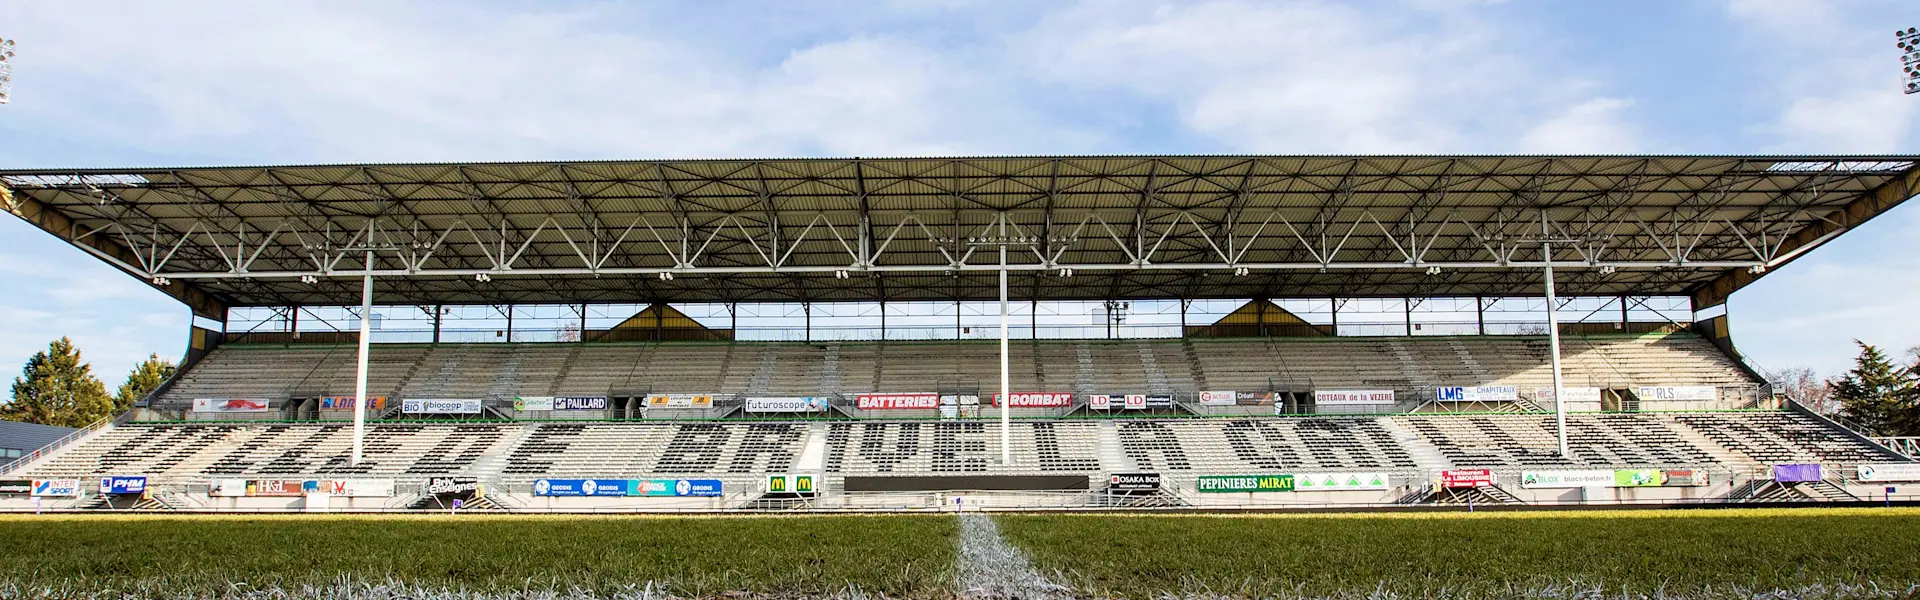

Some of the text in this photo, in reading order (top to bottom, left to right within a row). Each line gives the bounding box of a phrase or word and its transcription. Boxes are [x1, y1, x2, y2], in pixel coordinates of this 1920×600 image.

[1349, 393, 1358, 401] de
[1370, 393, 1393, 401] VEZERE
[1438, 387, 1464, 400] LMG
[1656, 387, 1675, 399] RLS
[567, 398, 605, 409] PAILLARD
[747, 400, 806, 410] futuroscope
[859, 396, 937, 408] BATTERIES
[1009, 394, 1071, 406] ROMBAT
[1091, 396, 1107, 405] LD
[1127, 396, 1143, 405] LD
[430, 402, 462, 410] biocoop
[113, 479, 146, 487] PHM
[1146, 475, 1160, 483] BOX
[1200, 477, 1293, 489] PEPINIERES MIRAT
[428, 482, 478, 493] Enseignes
